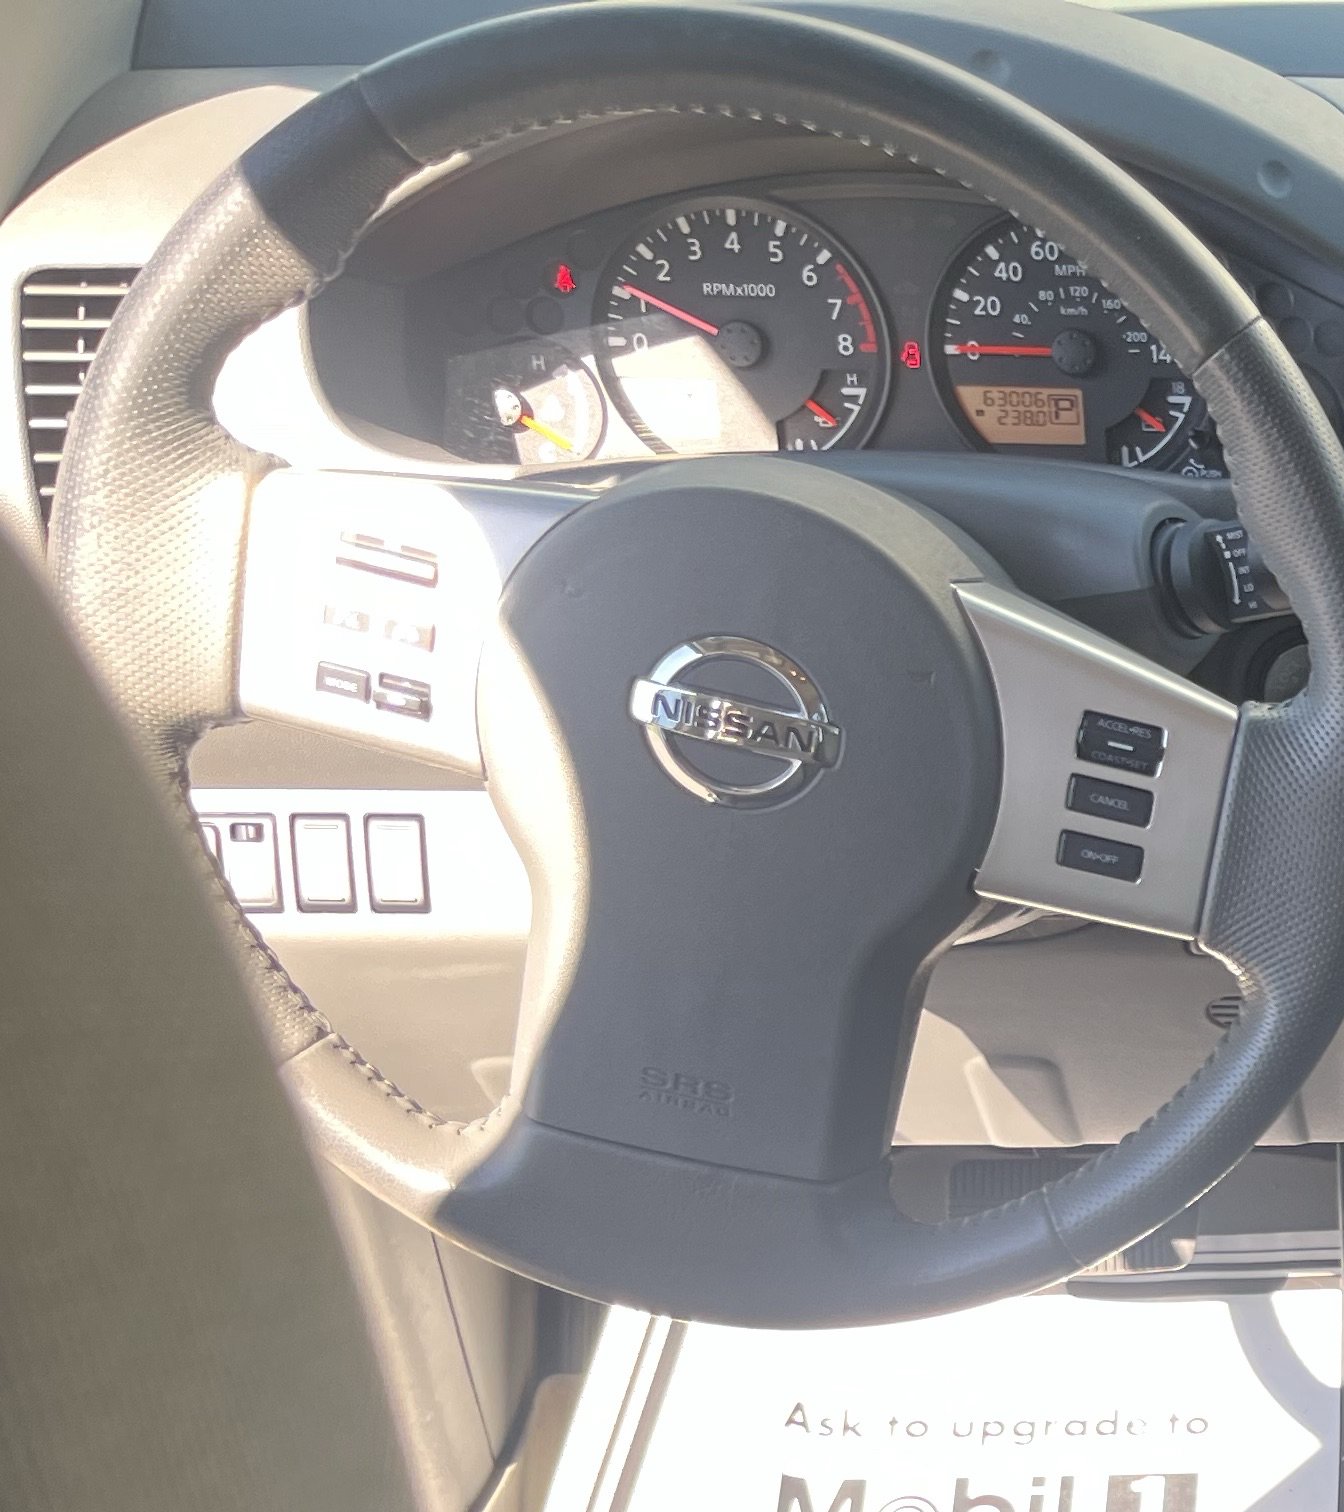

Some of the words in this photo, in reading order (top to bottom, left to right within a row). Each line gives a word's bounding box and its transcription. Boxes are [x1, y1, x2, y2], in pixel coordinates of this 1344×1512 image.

[688, 239, 701, 260] 3
[724, 232, 741, 253] 4
[768, 241, 783, 262] 5
[1030, 241, 1059, 261] 60
[655, 260, 671, 281] 2
[802, 265, 818, 286] 6
[994, 262, 1022, 281] 40
[1054, 264, 1086, 277] MPH
[703, 283, 776, 297] RPMx1000
[1038, 291, 1054, 301] 80
[1069, 287, 1088, 297] 120
[827, 299, 842, 320] 7
[973, 296, 1000, 316] 20
[1060, 306, 1088, 316] km/h
[1102, 299, 1121, 309] 160
[1013, 314, 1028, 324] 40
[633, 333, 648, 350] 0
[838, 334, 854, 355] 8
[1126, 332, 1148, 343] 200
[532, 355, 546, 371] H
[846, 373, 858, 385] H
[983, 390, 1046, 408] 63006
[1054, 398, 1074, 420] P
[1232, 548, 1246, 557] OFF
[651, 692, 817, 753] NISSAN
[1090, 793, 1129, 811] CANCEL
[784, 1402, 862, 1437] Ask
[889, 1416, 928, 1437] to
[952, 1410, 1146, 1446] upgrade
[1169, 1414, 1209, 1435] to
